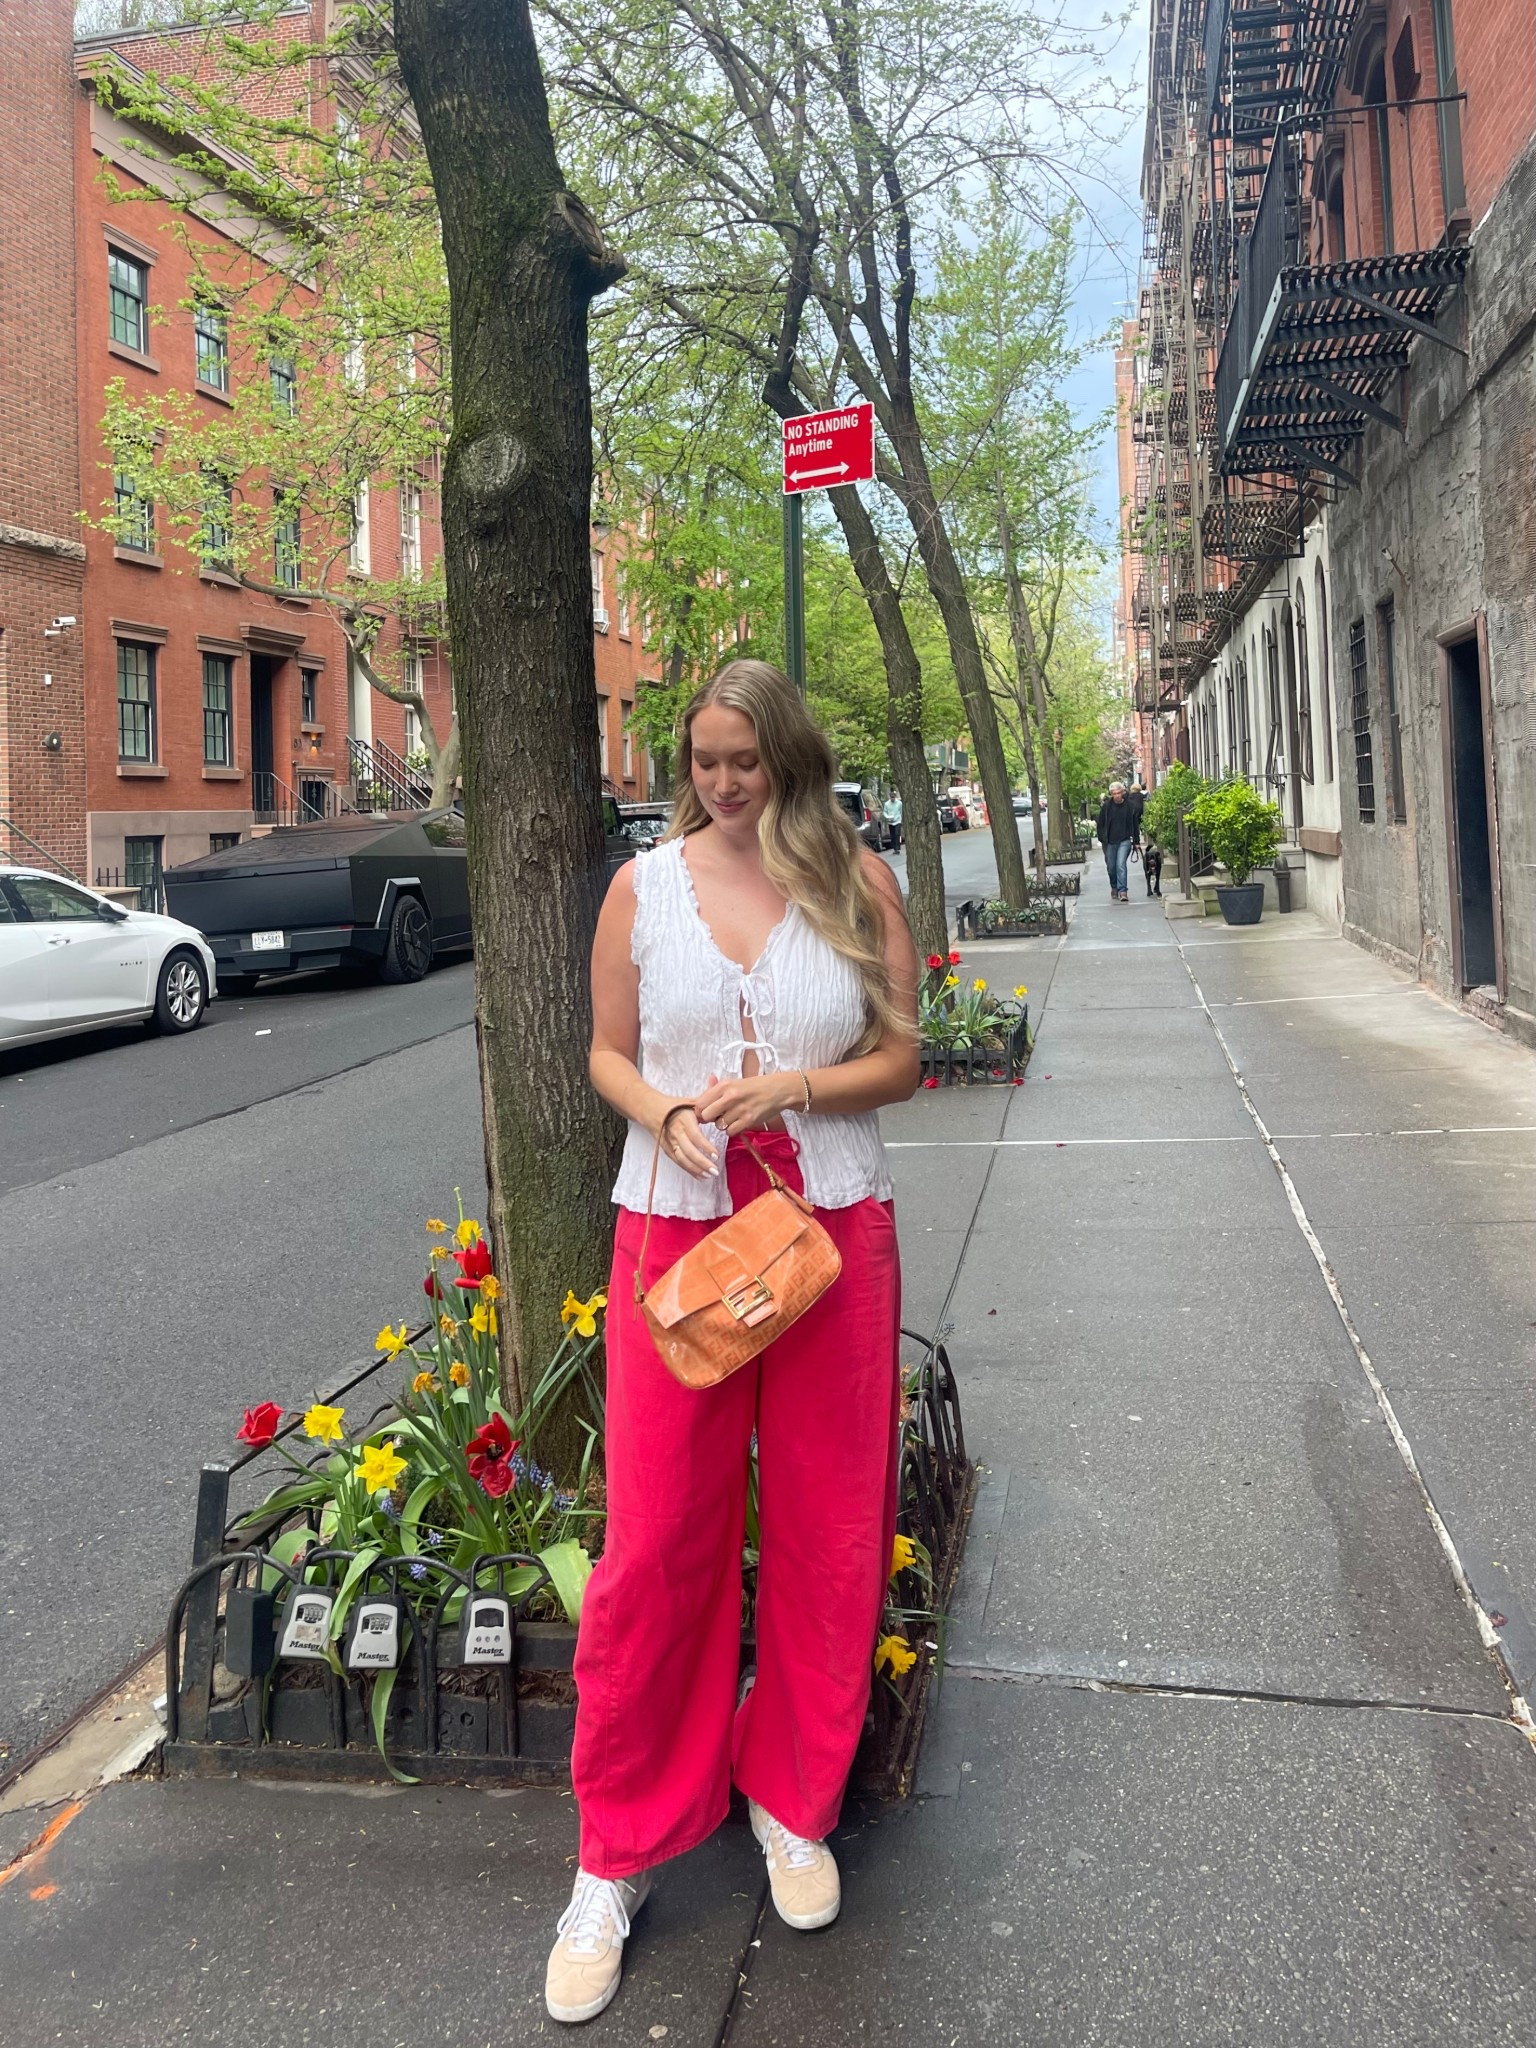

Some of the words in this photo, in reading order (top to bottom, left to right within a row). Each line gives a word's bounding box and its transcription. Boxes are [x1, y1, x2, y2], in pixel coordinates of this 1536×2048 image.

[788, 425, 803, 440] NO
[805, 414, 859, 436] STANDING
[788, 438, 833, 457] Anytime
[289, 1640, 320, 1650] Master
[472, 1647, 503, 1655] Master
